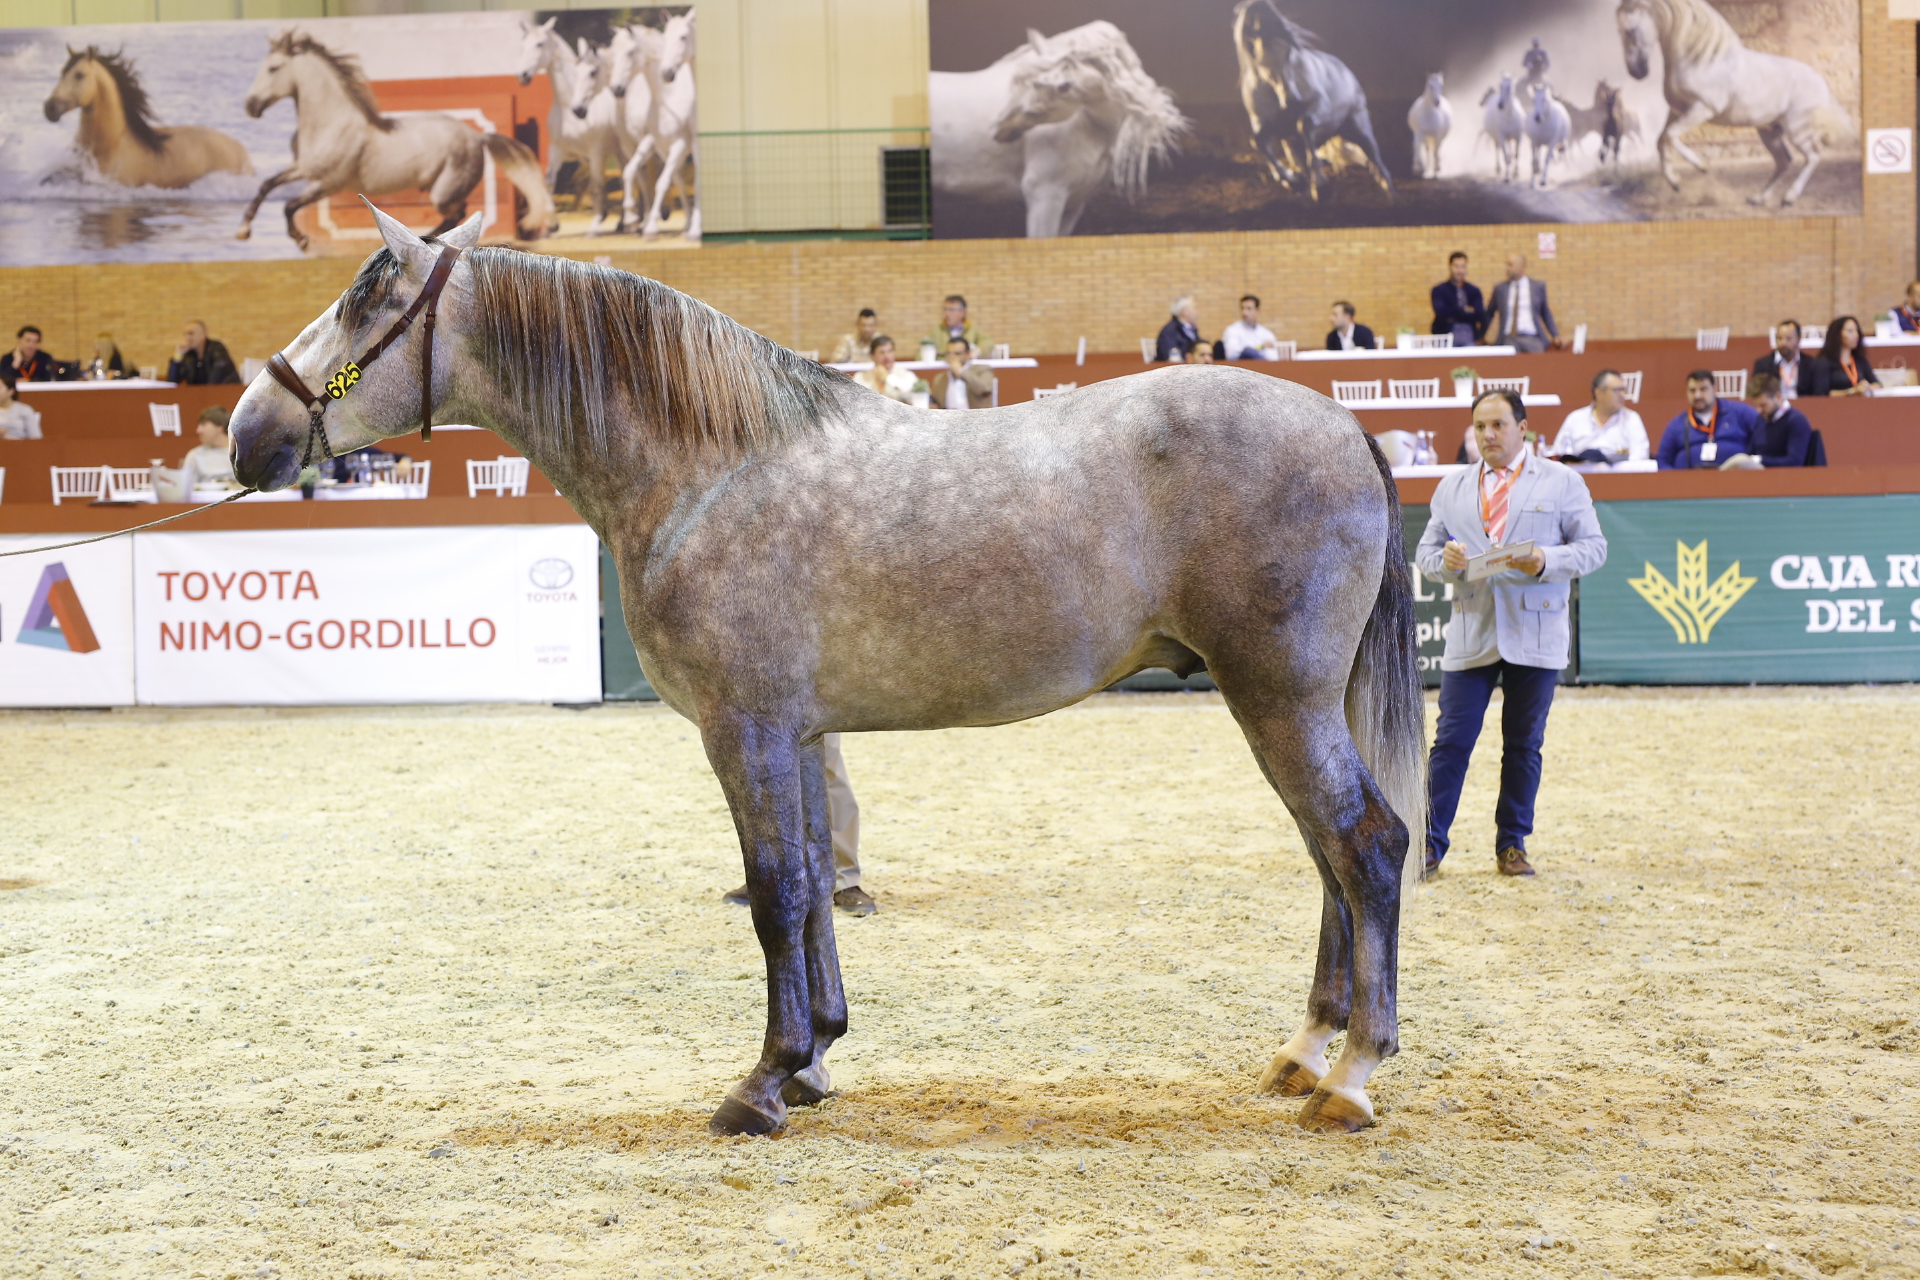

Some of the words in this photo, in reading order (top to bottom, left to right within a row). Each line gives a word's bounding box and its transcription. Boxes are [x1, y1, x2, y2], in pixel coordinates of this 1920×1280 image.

[324, 361, 362, 400] 625
[158, 570, 320, 602] TOYOTA
[1769, 554, 1878, 592] CAJA
[1885, 554, 1920, 588] R
[526, 592, 578, 603] TOYOTA
[1804, 598, 1897, 634] DEL
[160, 617, 497, 651] NIMO-GORDILLO
